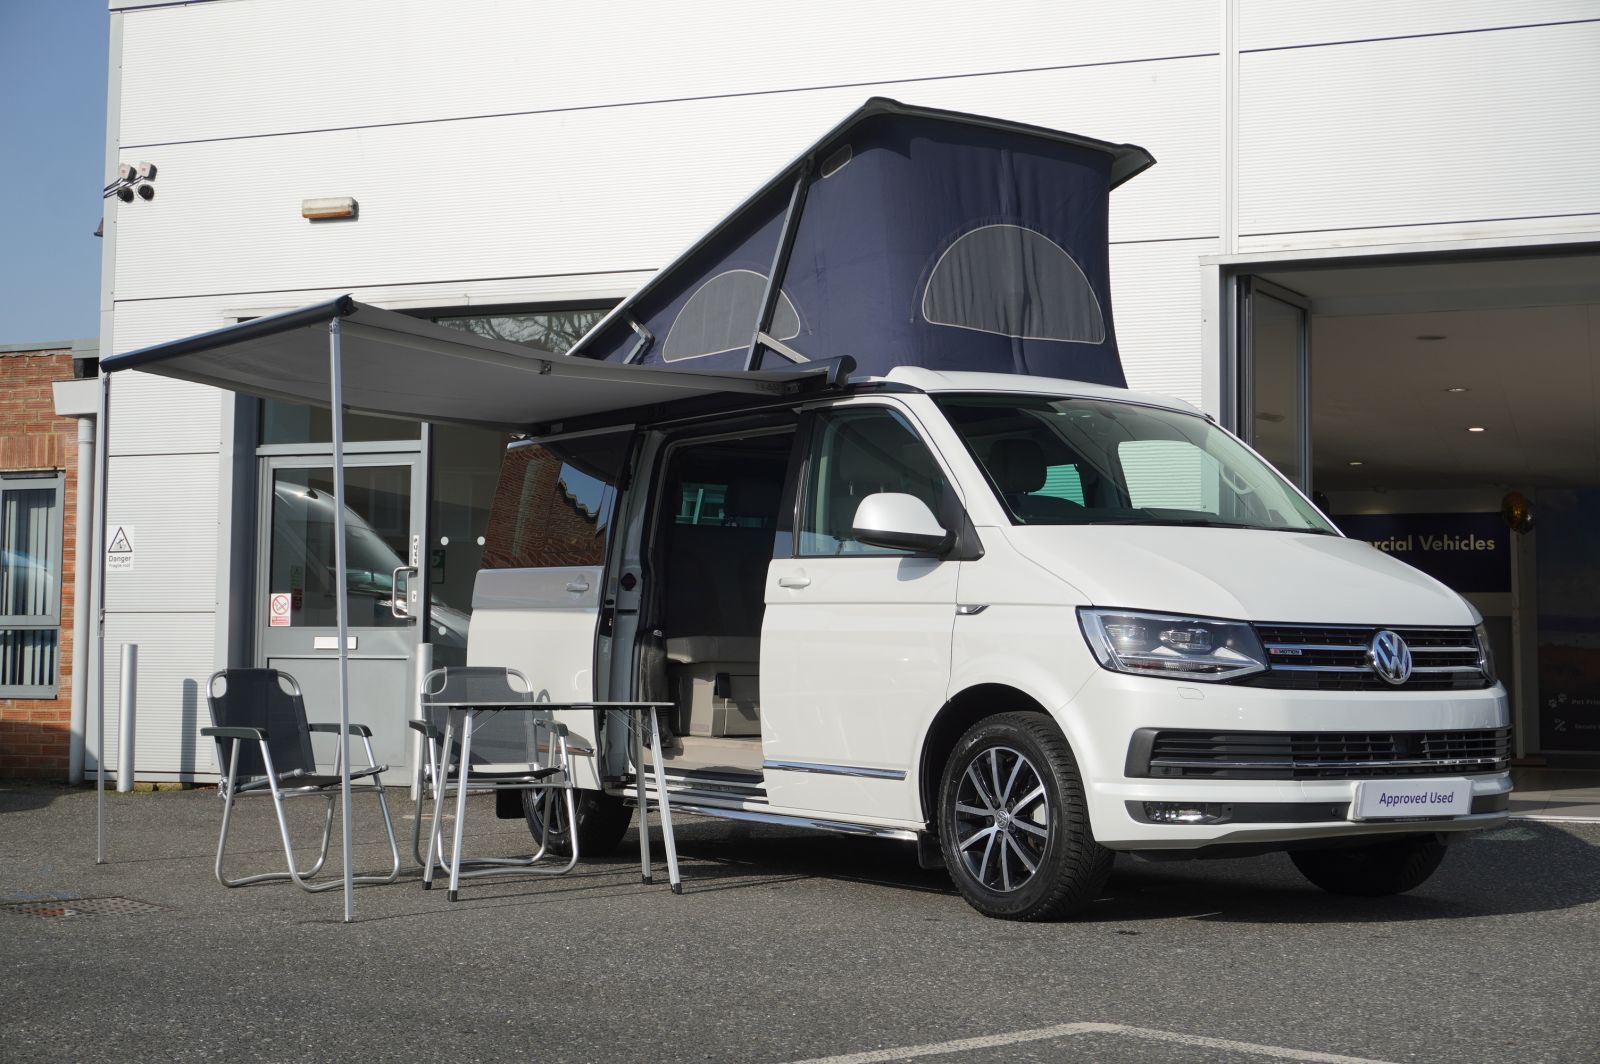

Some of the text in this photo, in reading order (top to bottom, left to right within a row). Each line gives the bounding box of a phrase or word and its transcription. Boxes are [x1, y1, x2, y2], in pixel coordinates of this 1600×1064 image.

[1366, 534, 1496, 551] rcial Vehicles
[109, 555, 131, 563] Danger
[1379, 792, 1454, 807] Approved Used
